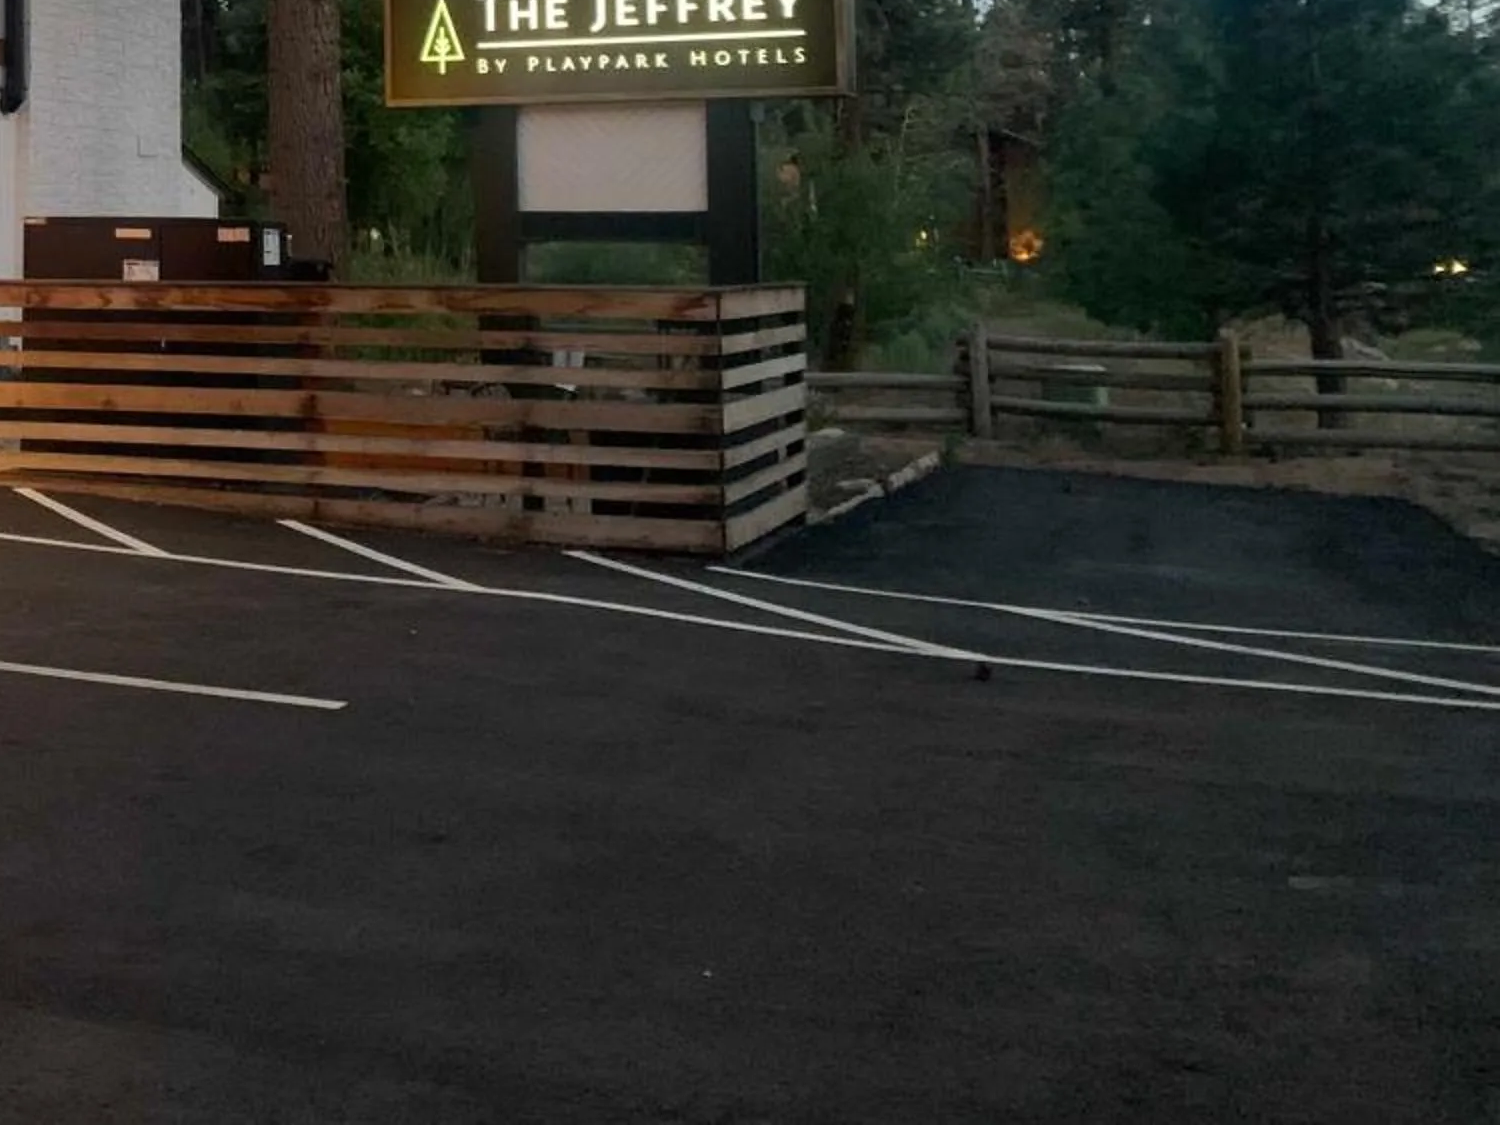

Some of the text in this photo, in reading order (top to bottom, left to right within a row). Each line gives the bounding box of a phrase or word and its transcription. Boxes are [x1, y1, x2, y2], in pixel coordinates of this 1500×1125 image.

[476, 47, 805, 74] BY PLAYPARK HOTELS
